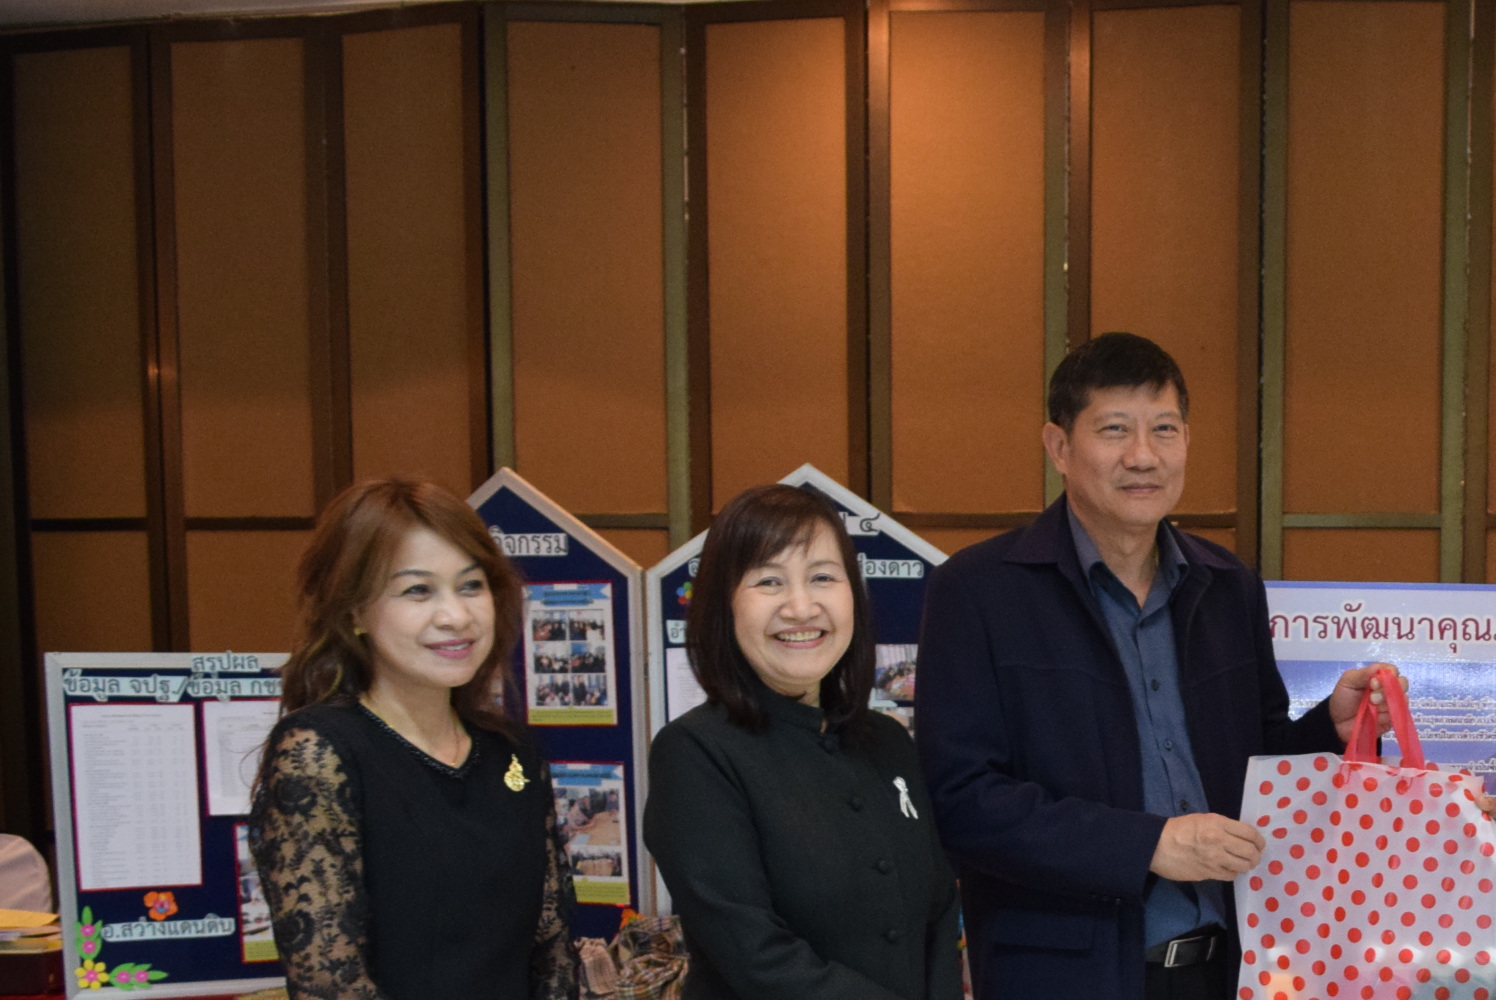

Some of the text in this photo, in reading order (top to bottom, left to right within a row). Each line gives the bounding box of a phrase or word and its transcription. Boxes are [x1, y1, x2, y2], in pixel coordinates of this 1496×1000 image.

[858, 553, 923, 577] ่องดาว
[63, 669, 120, 701] ข้อมูล
